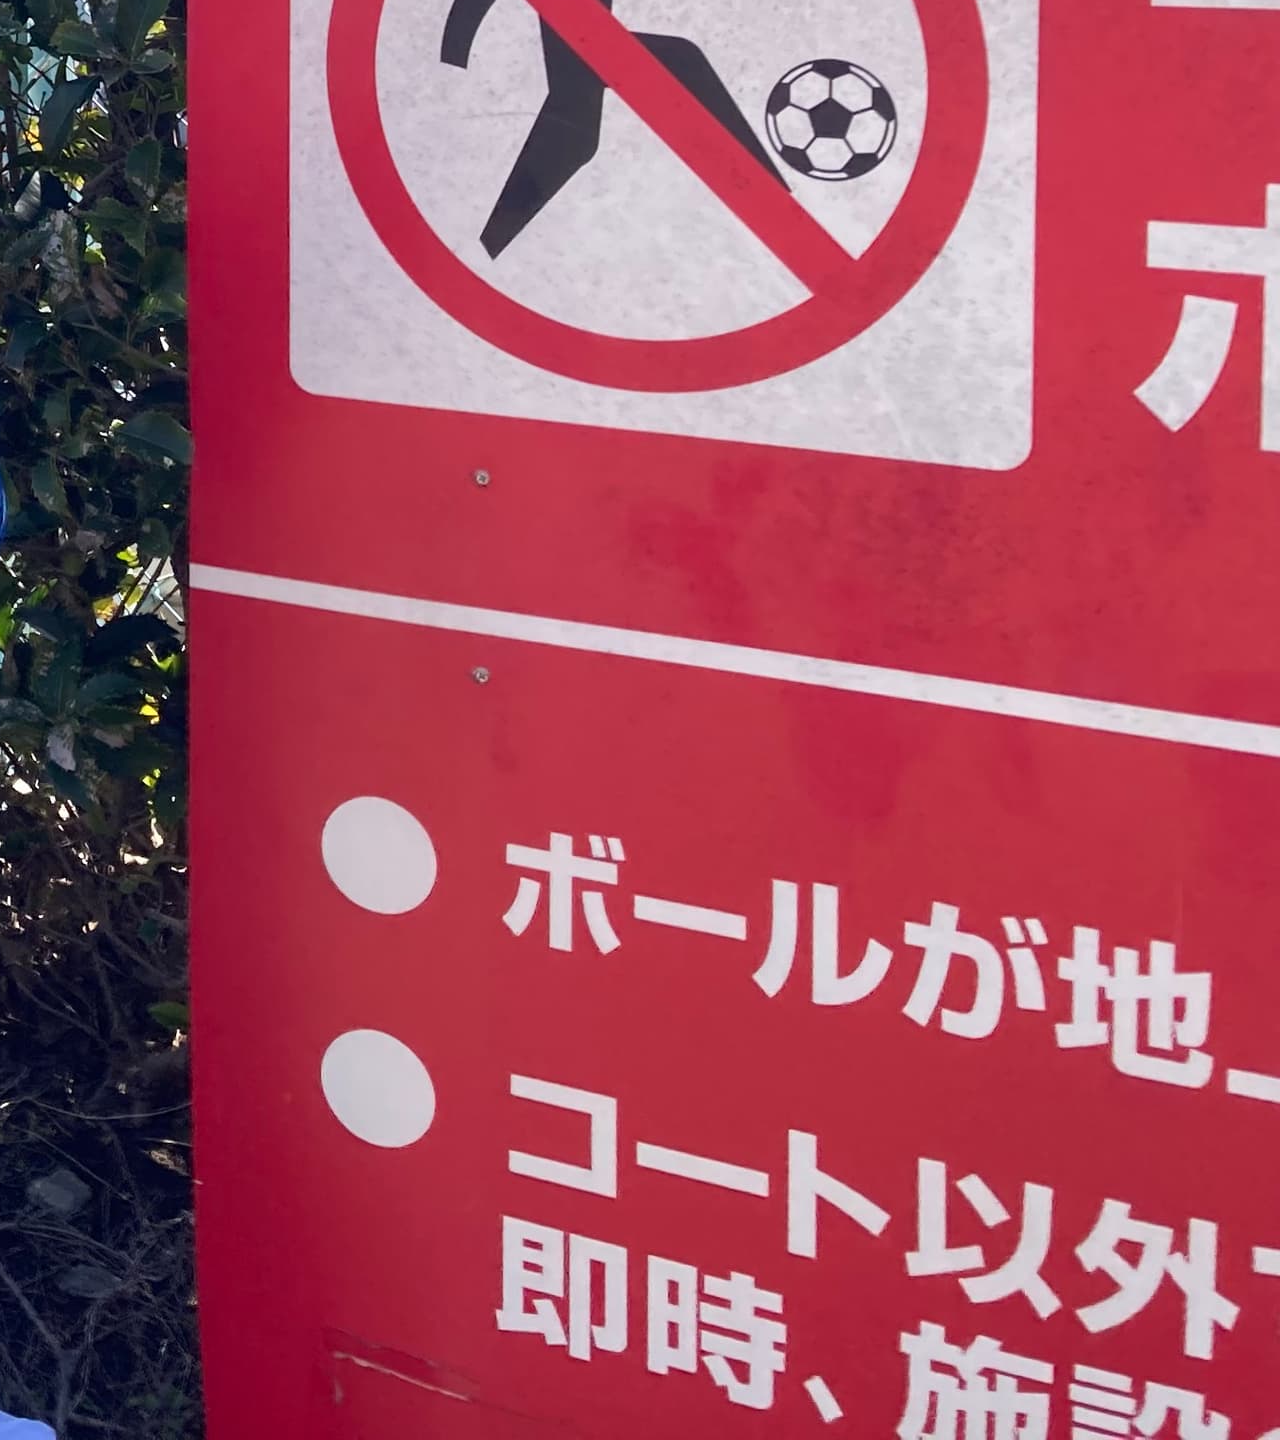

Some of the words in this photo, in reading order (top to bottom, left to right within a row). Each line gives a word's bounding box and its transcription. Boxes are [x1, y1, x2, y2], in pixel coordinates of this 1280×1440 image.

[502, 831, 1280, 1105] ボールが地
[507, 1072, 1280, 1359] コート以外
